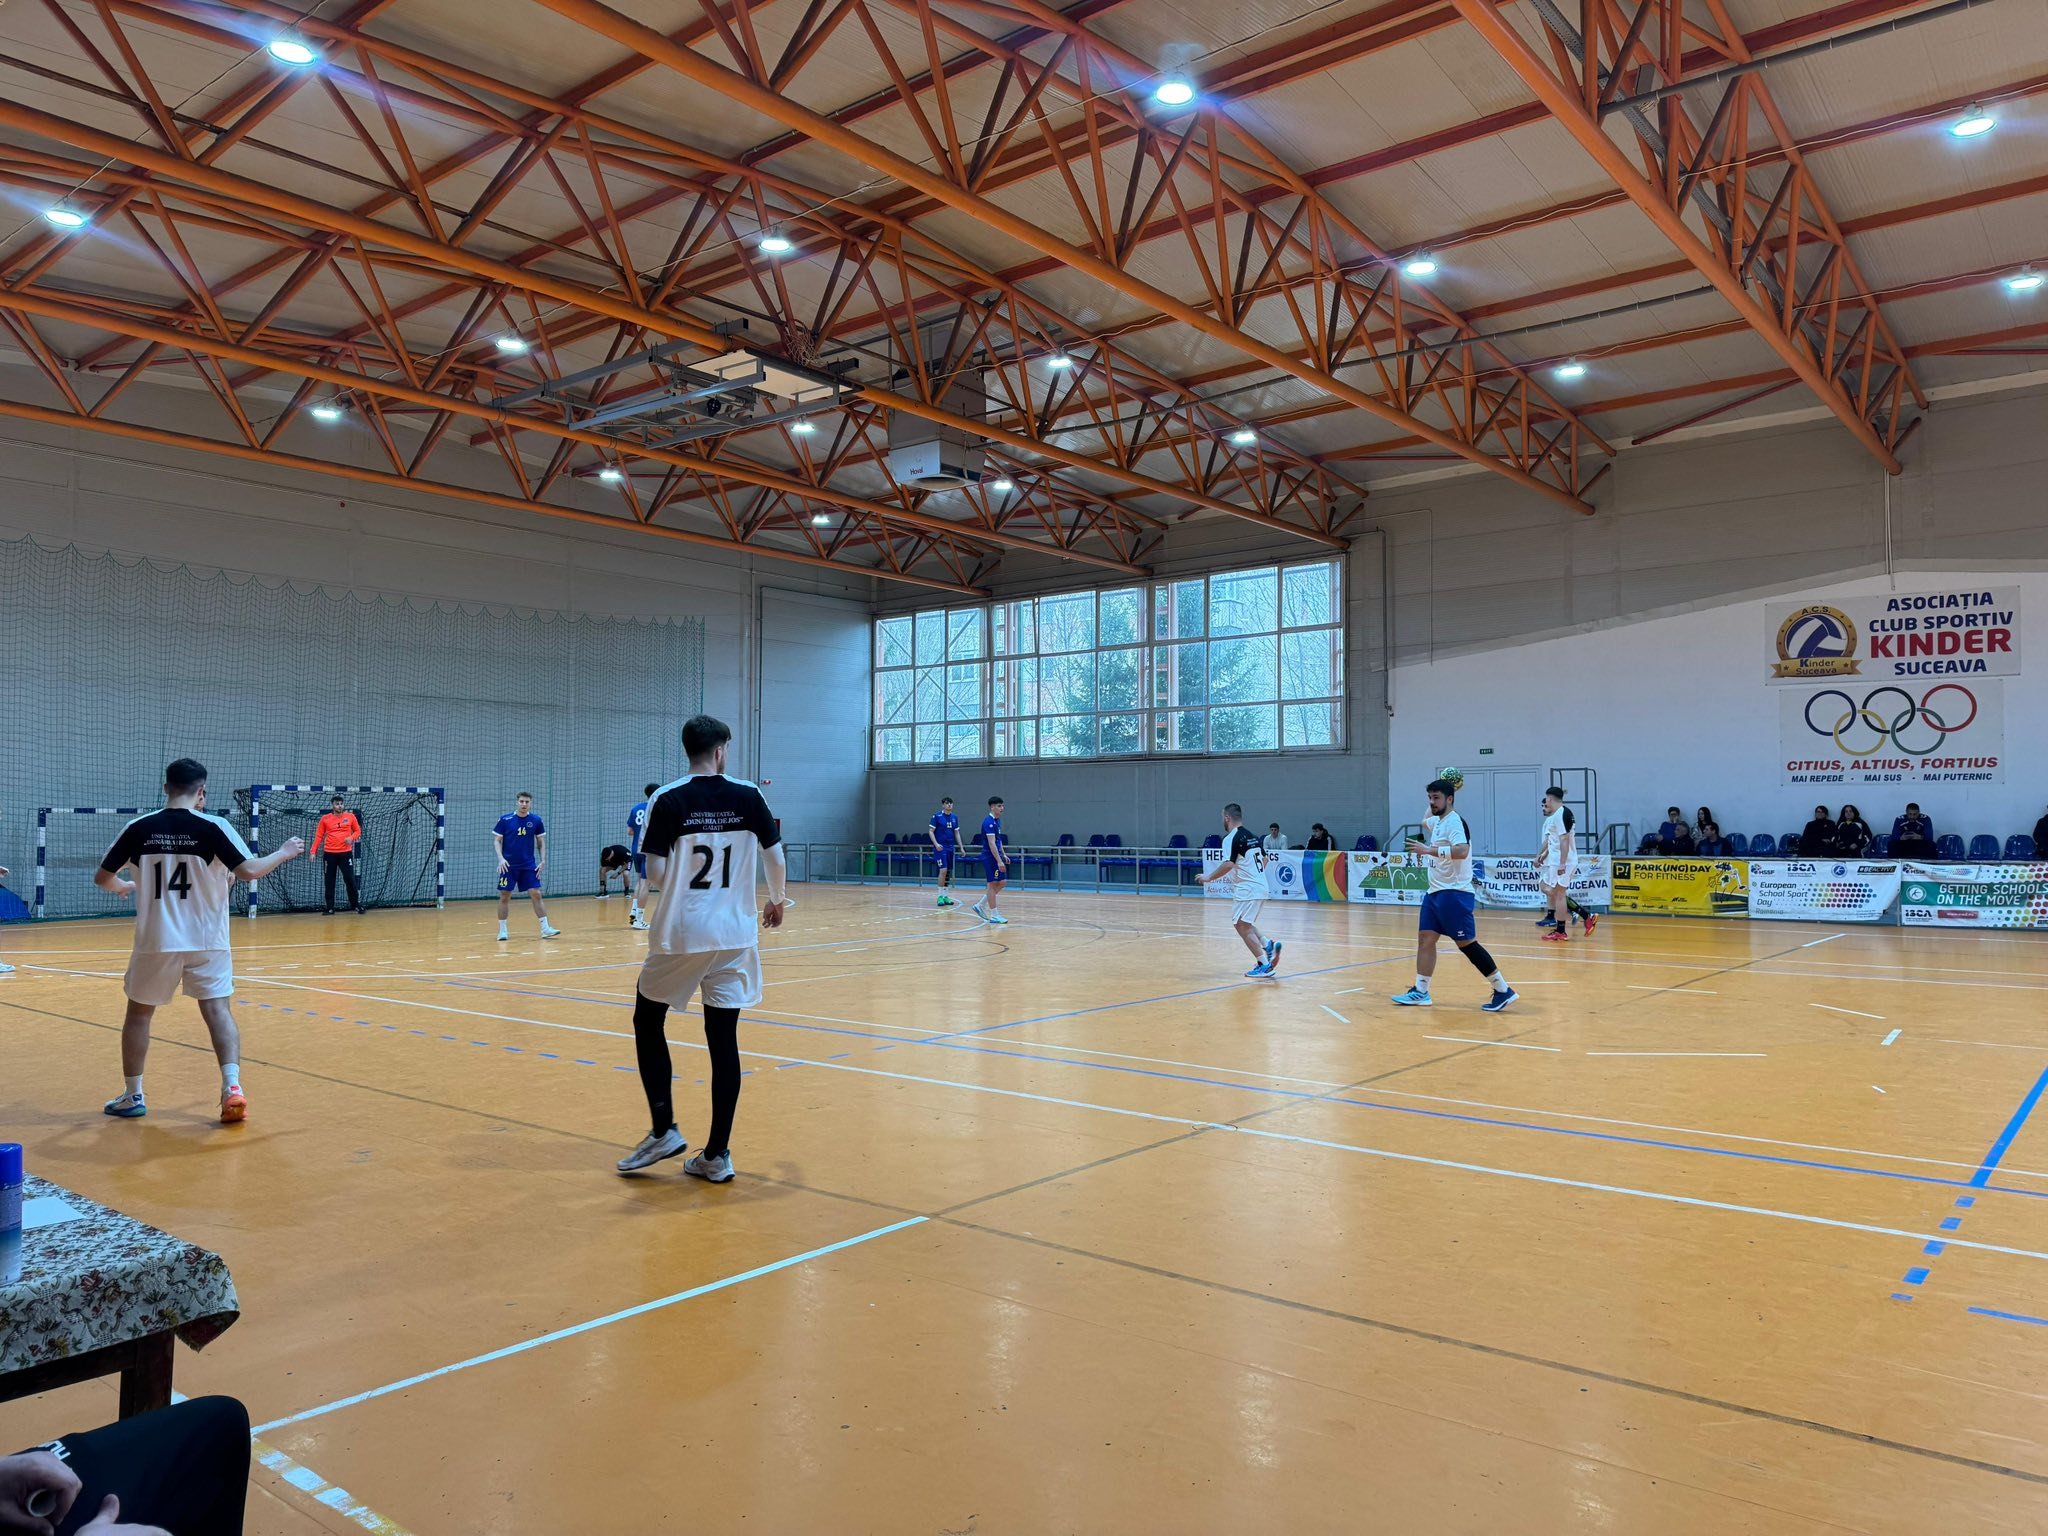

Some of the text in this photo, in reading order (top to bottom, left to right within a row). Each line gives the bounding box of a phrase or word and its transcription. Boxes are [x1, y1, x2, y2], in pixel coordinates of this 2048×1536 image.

[910, 467, 924, 475] Hoval
[1887, 592, 1994, 612] ASOCIAȚIA
[1869, 611, 2014, 633] CLUB SPORTIV
[1871, 628, 2013, 659] KINDER
[1800, 659, 1835, 668] Kinder
[1894, 658, 1987, 676] SUCEAVA
[1796, 667, 1837, 675] Suceava
[1787, 757, 1998, 773] CITIUS, ALTIUS, FORTIUS
[1791, 775, 1808, 783] MAI
[1810, 774, 1844, 783] REPEDE
[1864, 774, 1882, 782] MAI
[1884, 774, 1902, 782] SUS
[1944, 773, 1993, 781] PUTERNIC
[689, 844, 732, 889] 21
[994, 869, 999, 877] 6
[1634, 872, 1696, 881] FOR FITNESS
[154, 861, 192, 899] 14
[1760, 881, 1797, 889] European
[1502, 883, 1540, 893] PENTRU
[1939, 883, 2048, 895] GETTING SCHOOLS
[1787, 890, 1808, 898] Sport
[1757, 898, 1772, 906] Day
[1936, 894, 2021, 905] ON THE MOVE
